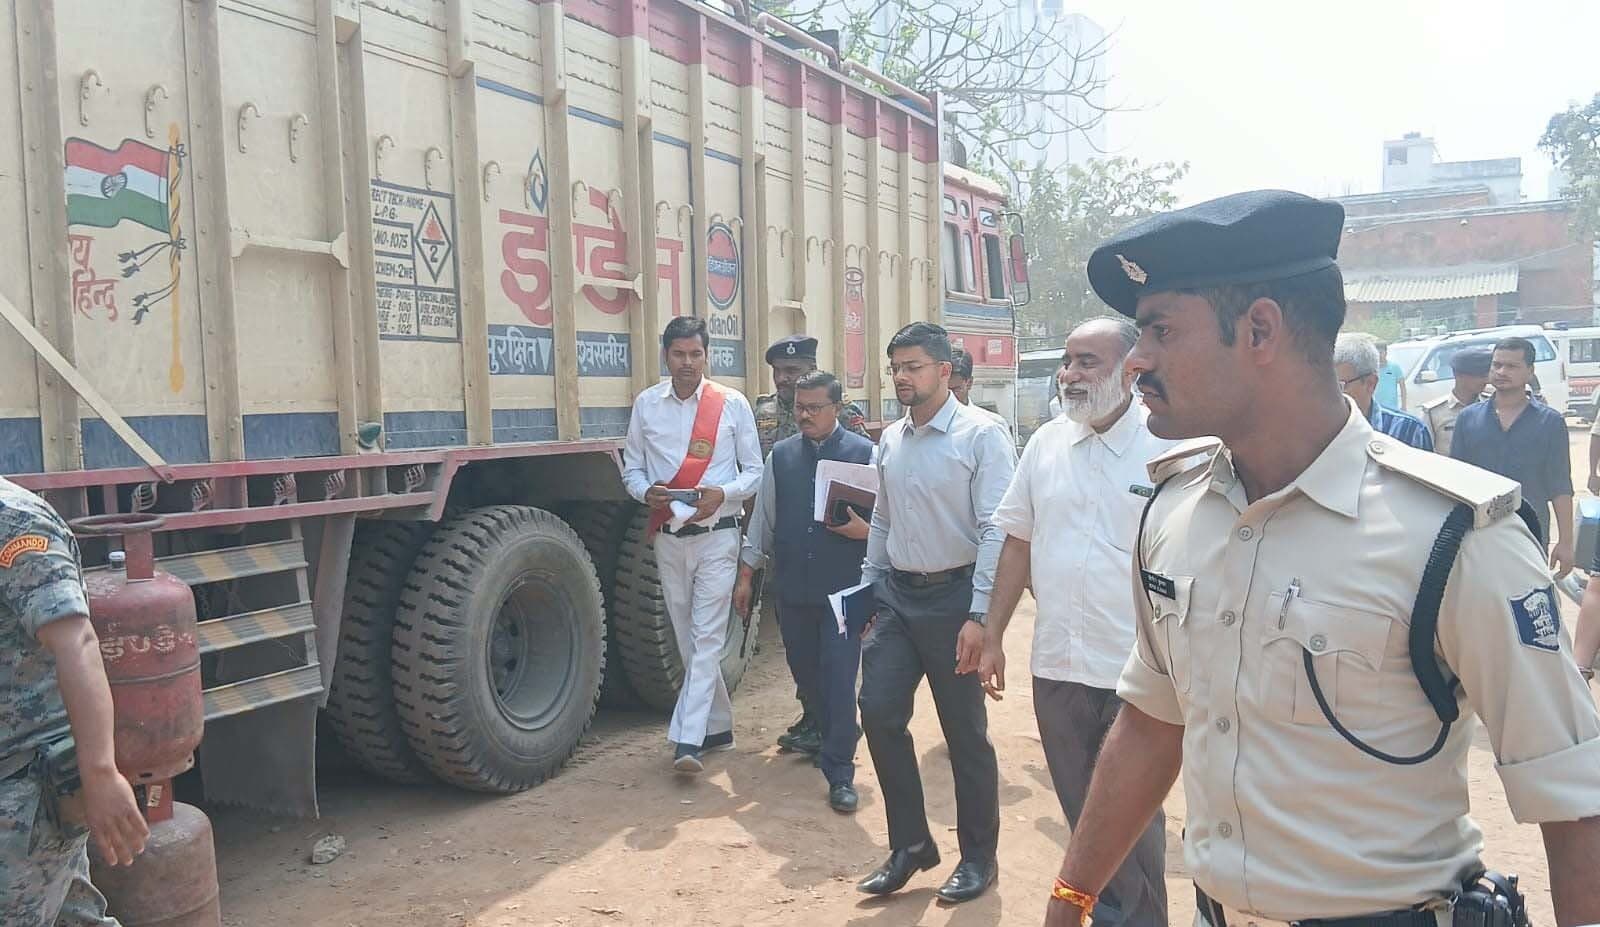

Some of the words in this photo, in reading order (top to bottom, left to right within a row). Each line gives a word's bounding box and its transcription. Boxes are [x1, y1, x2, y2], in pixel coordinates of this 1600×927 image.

[429, 245, 439, 263] 2
[398, 301, 412, 312] 100
[398, 312, 411, 323] 101
[397, 324, 412, 335] 102
